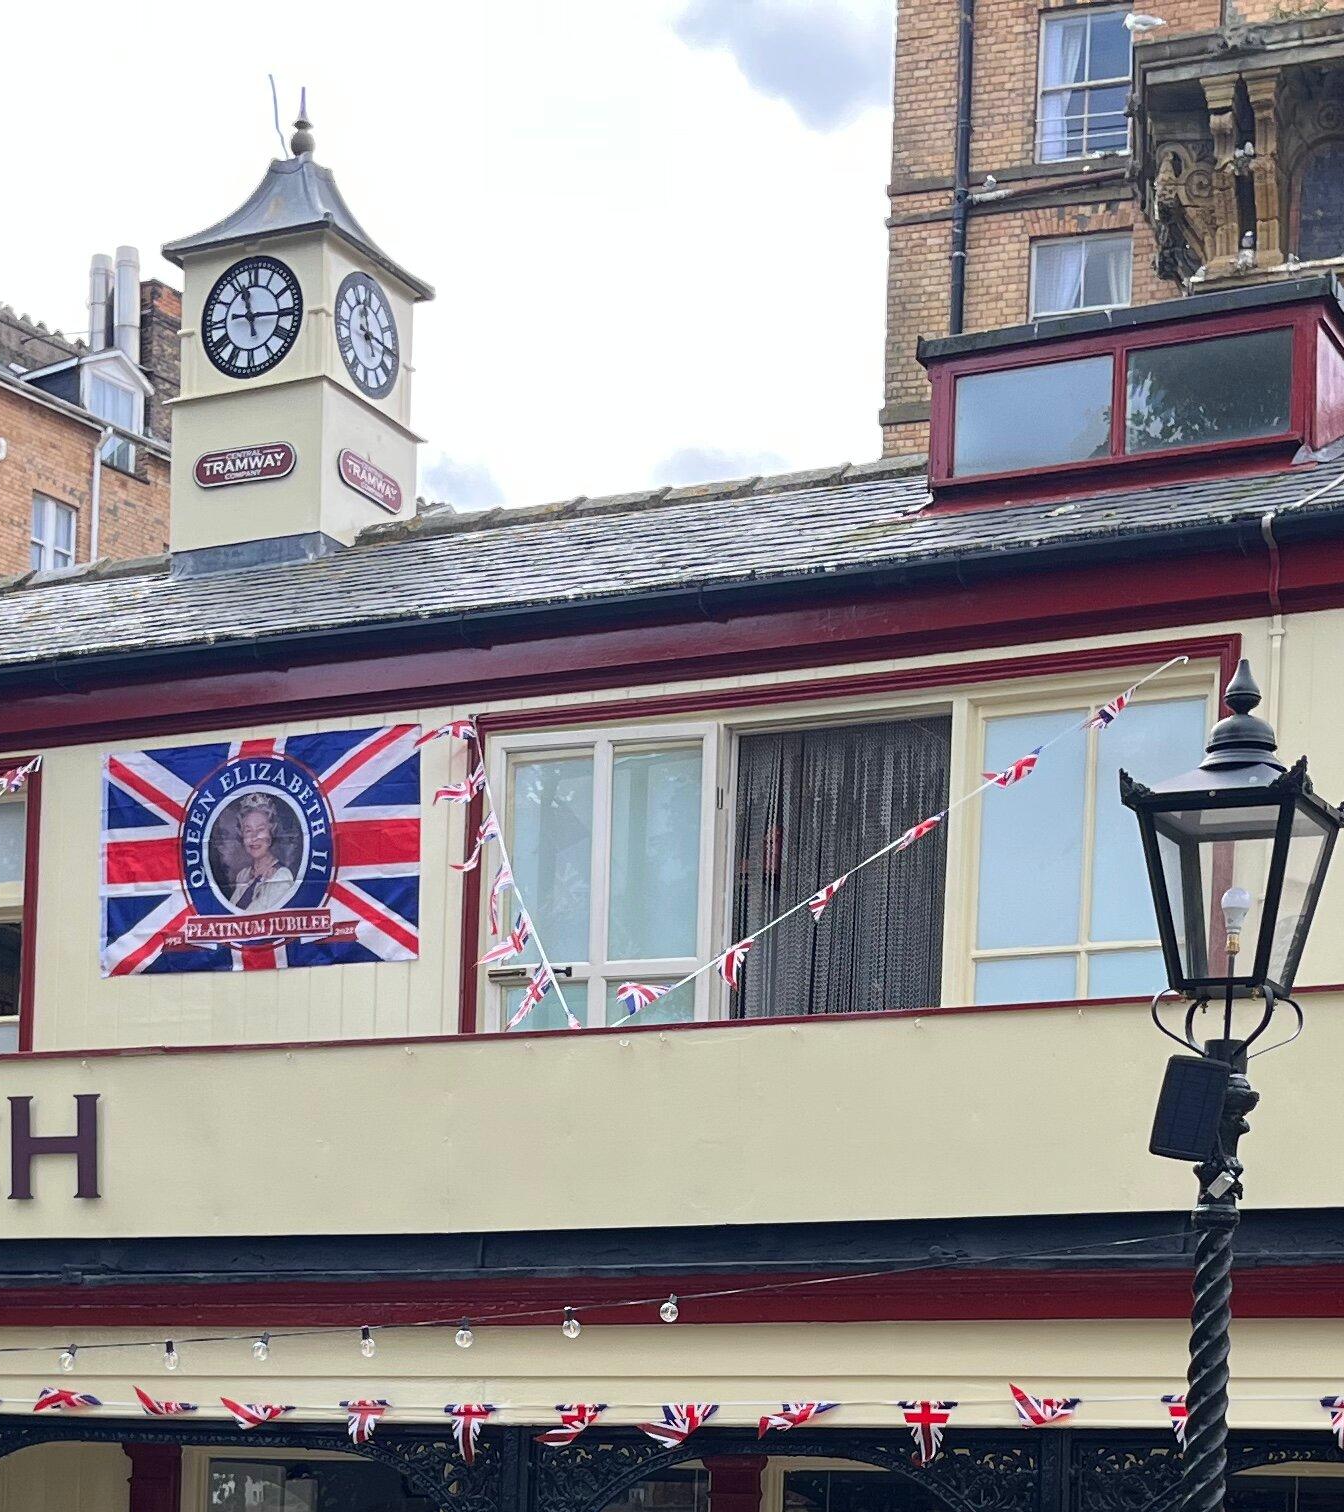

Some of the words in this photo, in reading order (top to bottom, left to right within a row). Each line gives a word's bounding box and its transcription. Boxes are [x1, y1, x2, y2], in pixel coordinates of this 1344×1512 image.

[203, 453, 285, 476] TRAMWAY
[346, 459, 398, 500] TRAMWAY
[185, 790, 216, 888] QUEEN
[219, 763, 327, 836] ELIZABETH
[309, 849, 329, 874] II
[188, 918, 266, 939] PLATINUM
[268, 916, 330, 936] JUBILEE
